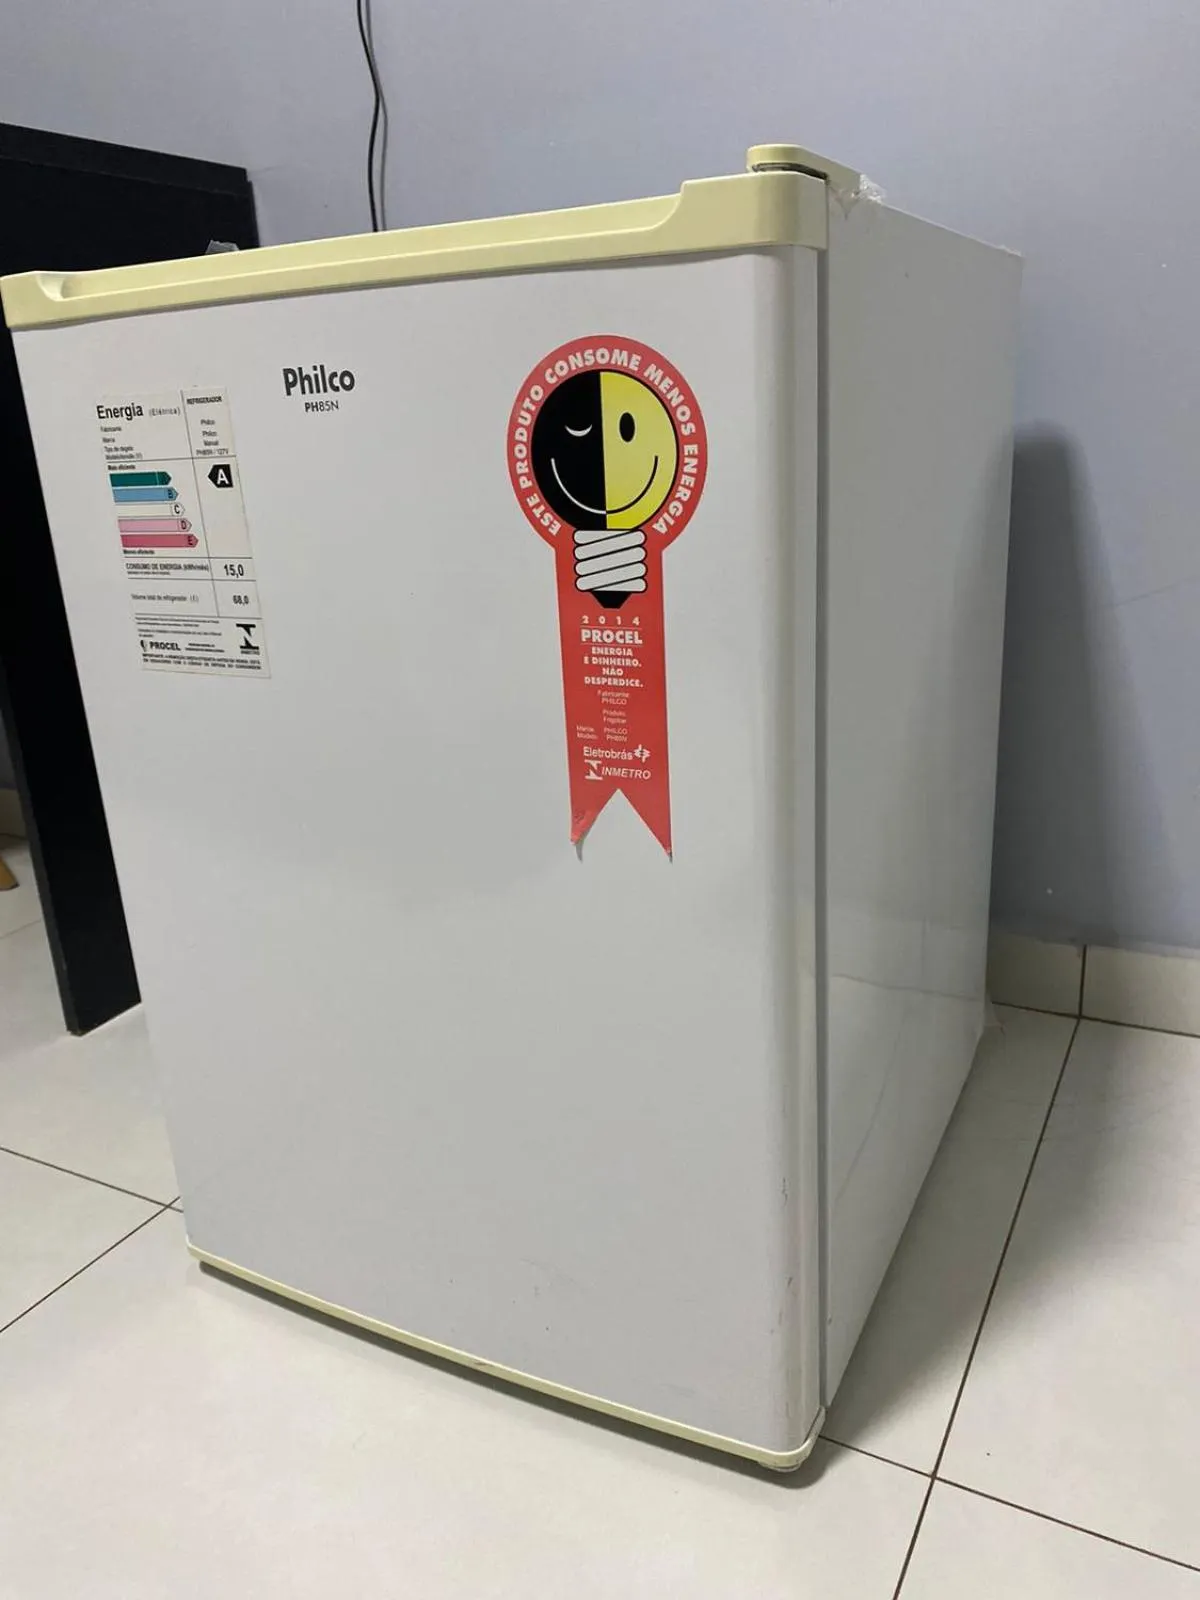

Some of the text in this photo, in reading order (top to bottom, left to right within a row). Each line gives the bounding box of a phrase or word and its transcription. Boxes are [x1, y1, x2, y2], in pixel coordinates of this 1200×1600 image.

[283, 364, 355, 396] Philco
[96, 402, 144, 420] Energia
[305, 400, 339, 412] PH85N
[514, 348, 698, 536] ESTE PRODUTO CONSOME MENOS ENERGIA
[216, 468, 230, 485] A
[174, 504, 180, 514] C
[181, 520, 187, 530] D
[187, 535, 193, 545] E
[223, 563, 244, 578] 15,0
[232, 595, 249, 605] 68,0
[580, 629, 643, 645] PROCEL
[149, 641, 181, 652] PROCEL
[591, 646, 633, 656] ENERGIA
[591, 656, 642, 667] DINHEIRO.
[584, 676, 643, 688] DESPERDICE.
[601, 697, 627, 705] PHILCO
[583, 746, 633, 760] Eletrobrás
[601, 766, 651, 780] INMETRO
